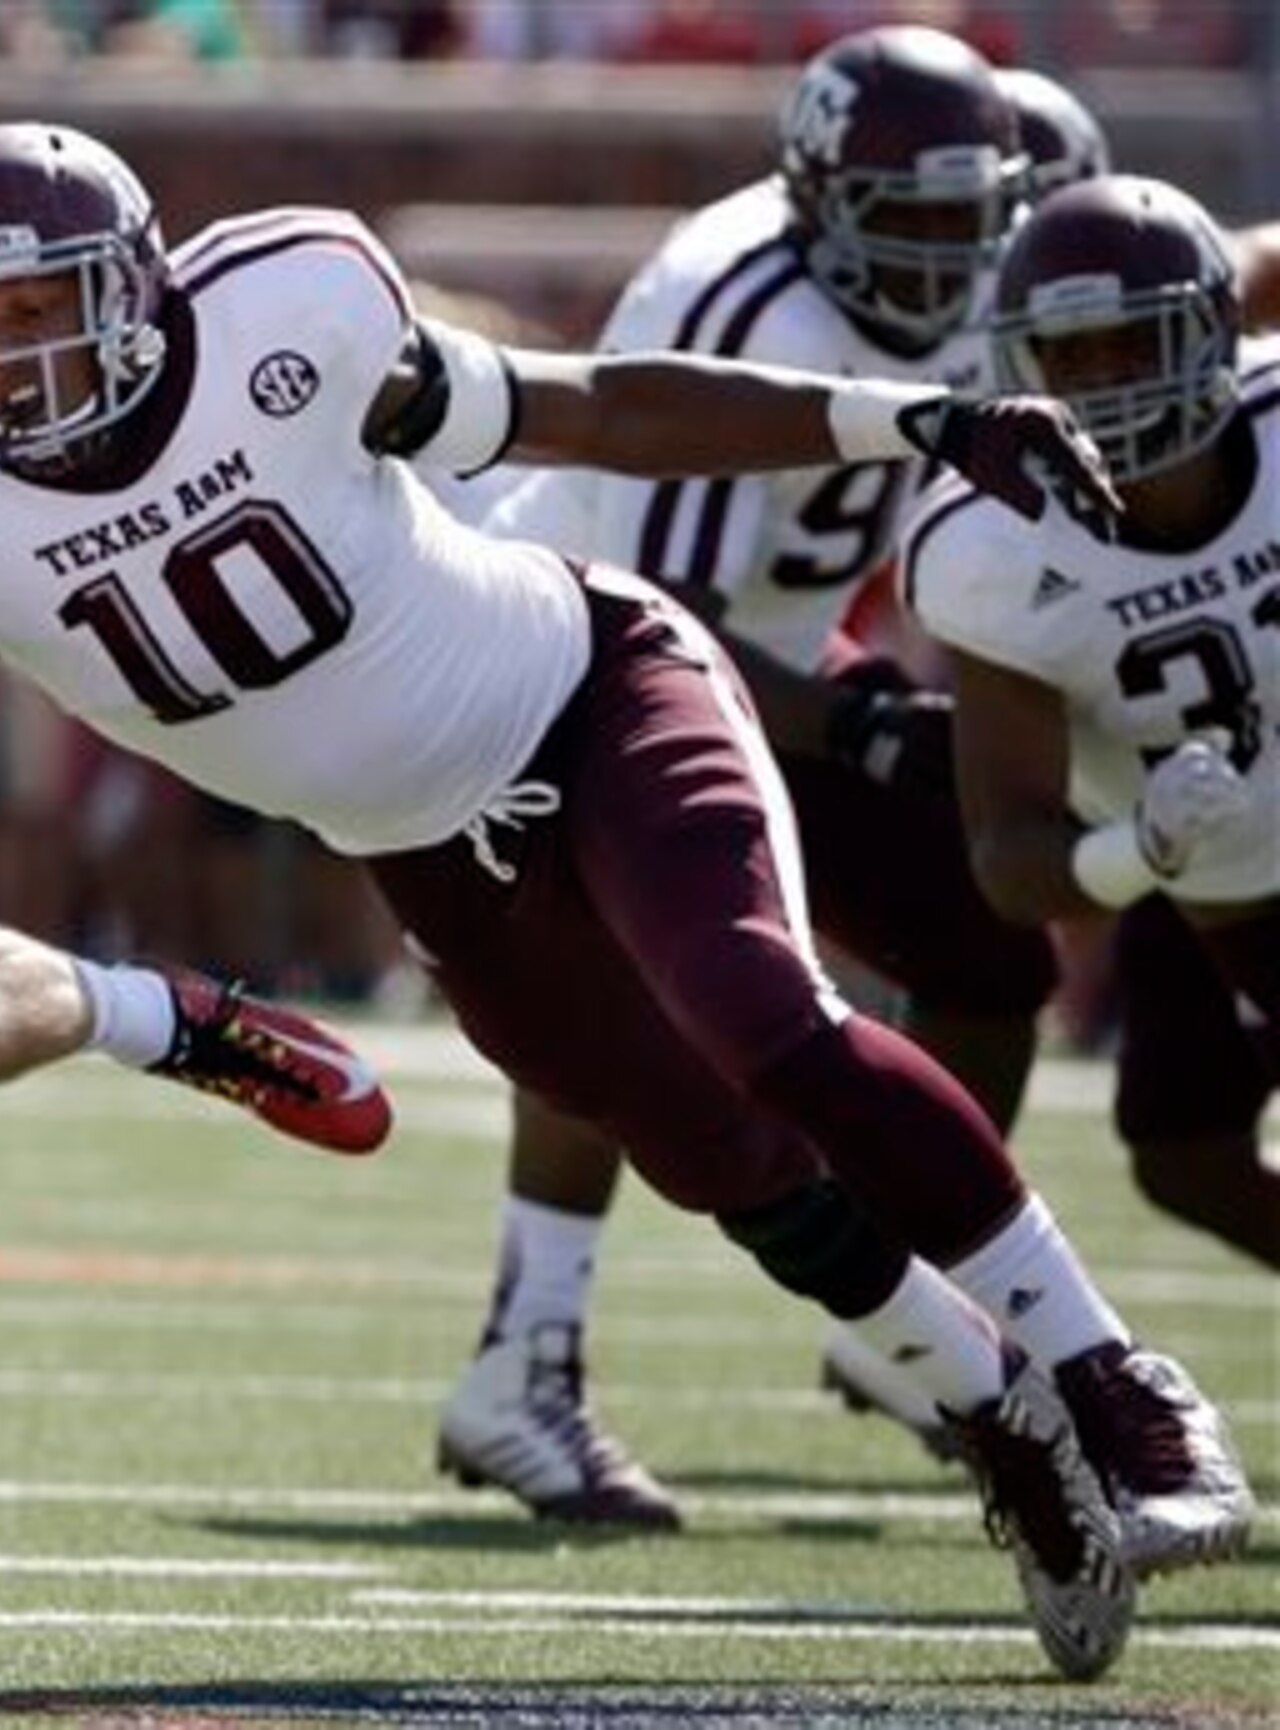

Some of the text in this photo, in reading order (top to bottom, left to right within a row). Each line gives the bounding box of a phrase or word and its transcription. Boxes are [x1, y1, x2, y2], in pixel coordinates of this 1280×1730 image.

[254, 358, 315, 412] SEC
[34, 503, 171, 576] TEXAS
[174, 449, 255, 519] A&M
[770, 456, 914, 590] 9
[57, 498, 355, 726] 10
[1106, 567, 1226, 628] TEXAS
